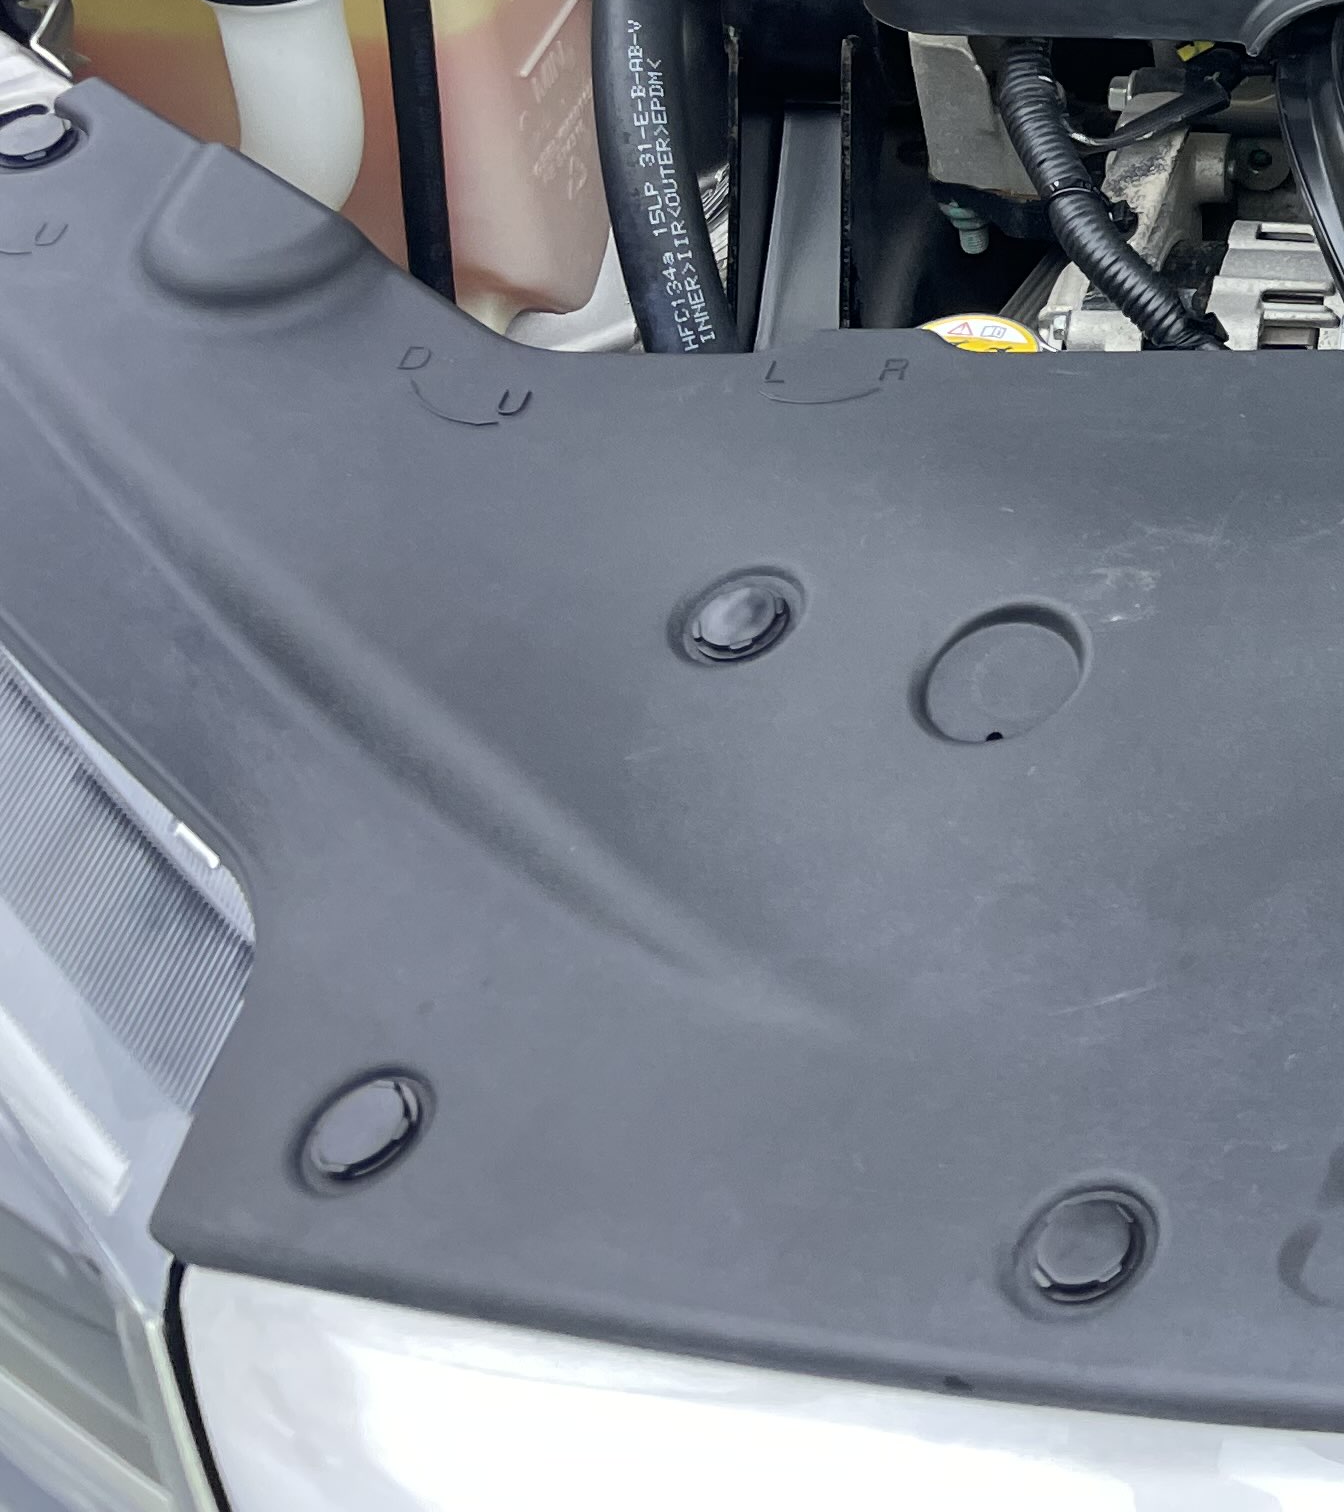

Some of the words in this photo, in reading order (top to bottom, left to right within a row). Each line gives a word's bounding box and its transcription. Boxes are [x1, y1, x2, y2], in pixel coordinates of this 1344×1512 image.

[627, 19, 656, 168] 31-E-B-AB-V
[644, 181, 668, 237] 15LP
[662, 251, 700, 353] HFC134a
[498, 388, 533, 417] U
